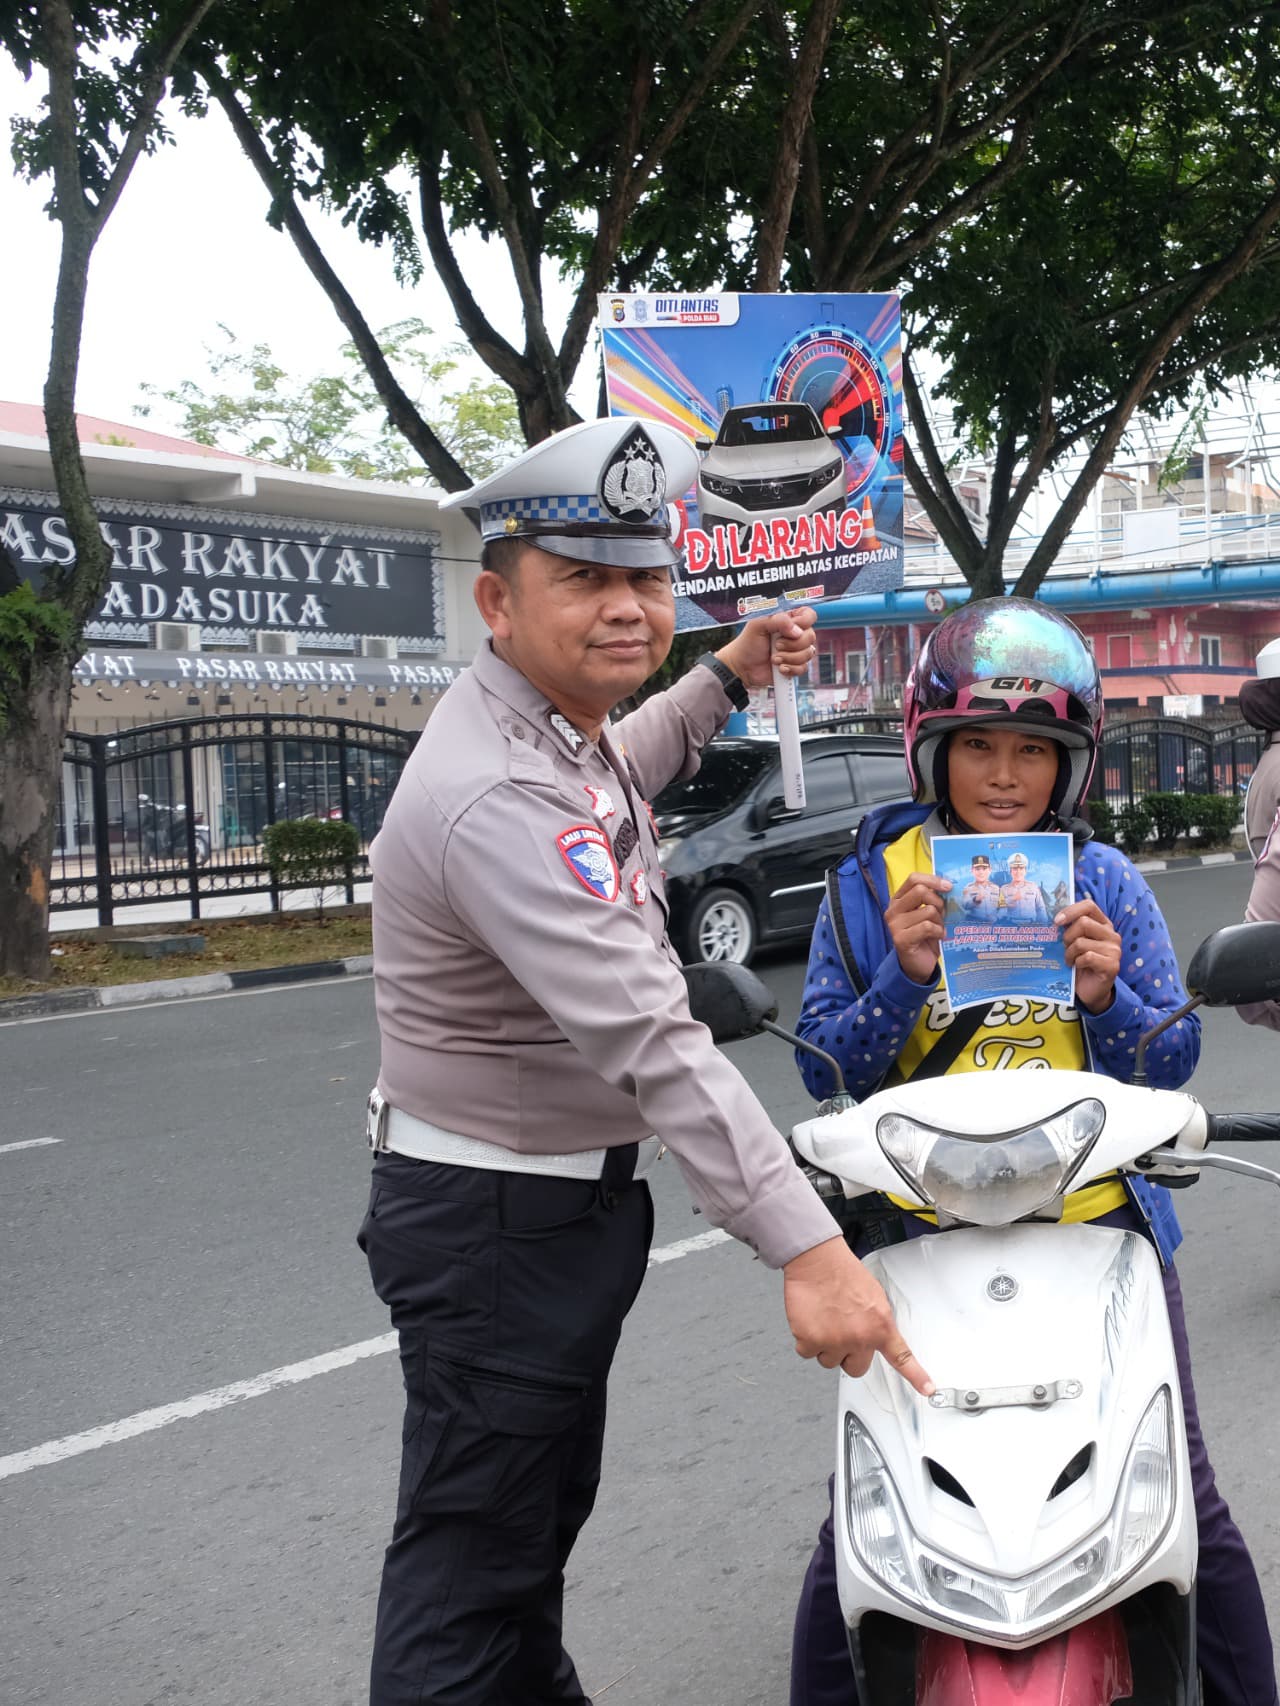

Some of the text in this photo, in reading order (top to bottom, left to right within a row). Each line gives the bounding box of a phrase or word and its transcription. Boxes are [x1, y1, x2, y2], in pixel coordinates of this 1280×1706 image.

[656, 299, 719, 312] DITLANTAS
[852, 338, 864, 350] 120
[775, 365, 783, 378] 40
[685, 508, 862, 572] DILARANG
[181, 531, 396, 590] RAKYAT
[737, 566, 795, 587] MELEBIHI
[797, 557, 832, 576] BATAS
[834, 546, 898, 570] KECEPATAN
[176, 657, 355, 682] PASAR RAKYAT
[388, 664, 454, 685] PASAR
[991, 677, 1043, 693] GM
